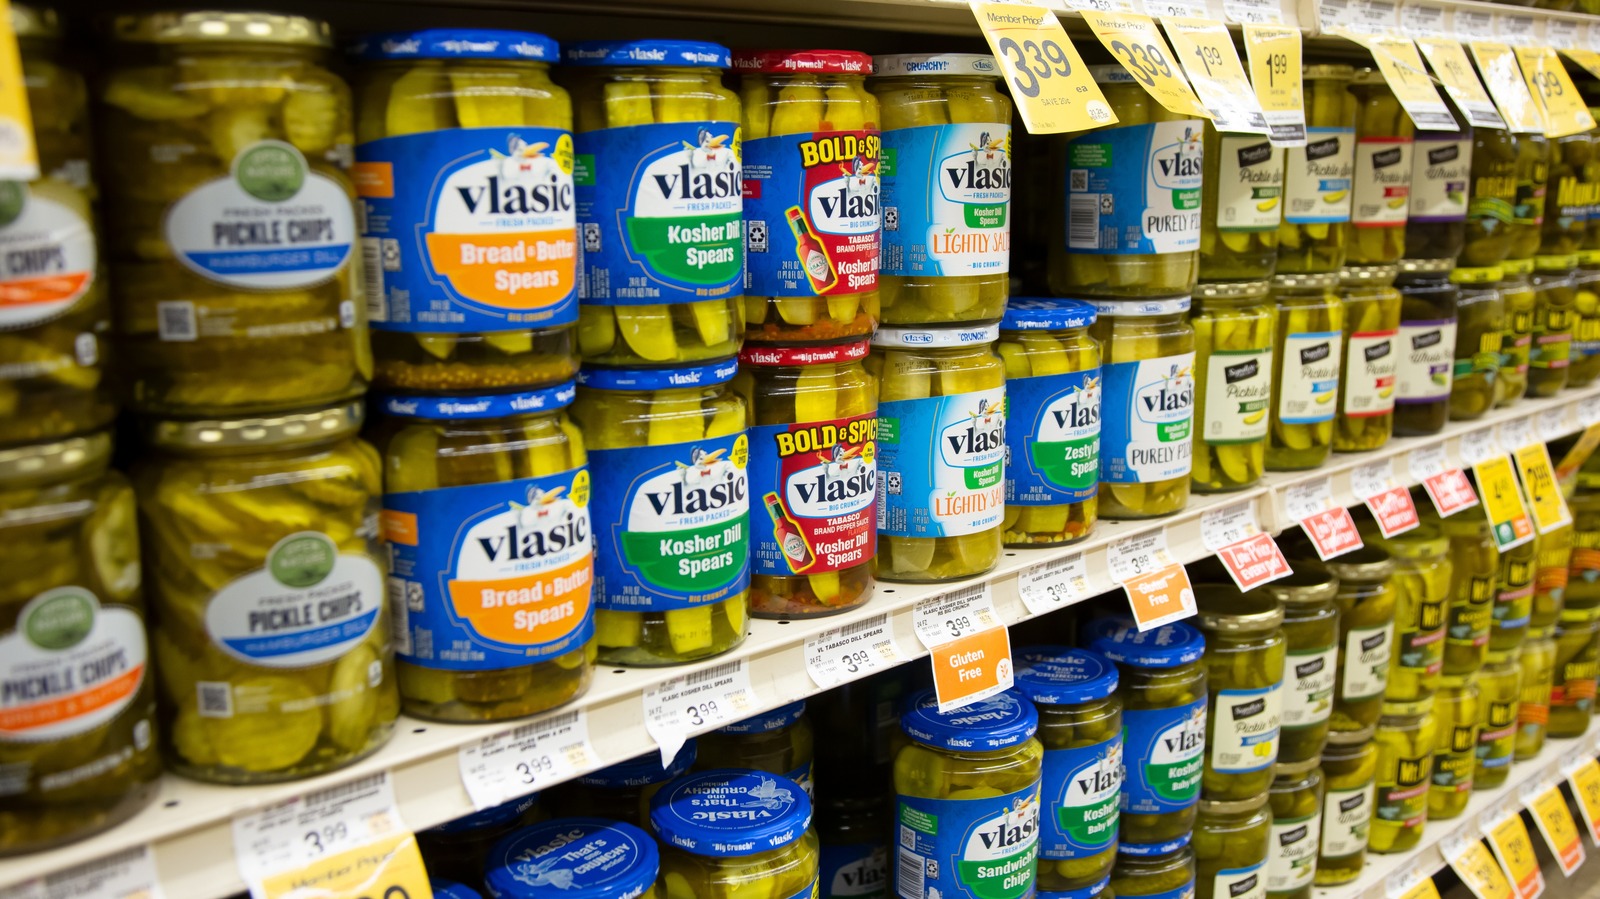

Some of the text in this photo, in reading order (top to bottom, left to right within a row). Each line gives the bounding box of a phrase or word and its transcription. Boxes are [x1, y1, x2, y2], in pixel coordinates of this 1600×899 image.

[987, 12, 1045, 26] Member Price!
[1096, 18, 1126, 29] Member
[629, 47, 666, 61] vlasic
[1195, 45, 1223, 77] 199
[734, 58, 763, 70] vlasic
[782, 59, 797, 70] "Big
[902, 60, 950, 73] "CRUNCHY!"
[999, 37, 1072, 98] 339
[1111, 40, 1172, 87] 339
[1266, 53, 1287, 87] 199
[1076, 85, 1088, 93] ea
[1041, 98, 1059, 106] SAVE
[800, 136, 857, 167] BOLD
[858, 139, 865, 153] &
[652, 162, 742, 200] vlasic
[945, 160, 1011, 190] vlasic
[455, 172, 572, 217] vlasic
[817, 184, 880, 219] vlasi
[687, 201, 733, 211] FRESH PACKED
[973, 207, 1003, 217] Kosher Dill
[849, 221, 859, 229] BIG
[979, 217, 999, 228] Spears
[1147, 212, 1188, 234] PURELY
[213, 218, 336, 247] PICKLE CHIPS
[667, 220, 741, 244] Kosher Dill
[848, 235, 875, 244] TABASCO
[836, 243, 871, 254] BRAND PEPPER
[933, 232, 991, 255] LIGHTLY
[459, 240, 526, 266] Bread
[686, 247, 734, 270] Spears
[837, 259, 871, 275] Kosher
[972, 261, 982, 269] BIG
[494, 269, 559, 295] Spears
[847, 273, 876, 290] Spears
[904, 334, 931, 342] vlasic
[750, 352, 782, 364] vlasic
[812, 351, 839, 362] Crunch!"
[669, 371, 702, 385] vlasic
[776, 425, 837, 457] BOLD
[839, 427, 847, 440] &
[848, 418, 878, 444] SPIC
[1065, 445, 1093, 461] Zesty
[1132, 446, 1175, 466] PURELY
[973, 467, 992, 478] Kosher
[1071, 459, 1098, 478] Spears
[794, 466, 875, 503] vlasic
[978, 475, 996, 486] Spears
[645, 472, 746, 516] vlasic
[828, 499, 860, 511] BIG CRUNCH
[935, 491, 989, 517] LIGHTLY
[679, 510, 730, 525] FRESH PACKED
[813, 517, 869, 536] BRAND PEPPER SAUCE
[826, 513, 861, 526] TABASCO
[478, 512, 586, 563] vlasic
[659, 522, 742, 557] Kosher Dill
[760, 541, 777, 550] 24 OZ
[815, 530, 869, 555] Kosher Dill
[678, 551, 733, 578] Spears
[827, 548, 862, 567] Spears
[1131, 554, 1150, 574] 399
[480, 566, 590, 609] Bread Butter
[1047, 582, 1068, 602] 399
[1138, 578, 1168, 596] Gluten
[923, 594, 983, 616] VLASIC KOSHER DILL SPEARS
[954, 603, 970, 612] CRUNCH
[1149, 594, 1170, 607] Free
[249, 590, 364, 633] PICKLE CHIPS
[513, 600, 575, 632] Spears
[916, 620, 922, 628] 24
[945, 616, 971, 637] 399
[825, 627, 883, 651] TABASCO DILL SPEARS
[810, 655, 822, 665] 24 FZ
[841, 650, 870, 674] 399
[949, 649, 985, 669] Gluten
[1024, 654, 1087, 665] vlasic
[1, 670, 76, 701] PICKLE
[80, 648, 129, 684] CHIPS
[958, 667, 983, 682] Free
[661, 677, 734, 703] VLASIC KOSHER DILL SPEARS
[686, 700, 718, 726] 399
[949, 710, 1013, 725] vlasic
[946, 737, 974, 747] vlasic
[986, 739, 998, 747] "Big
[516, 754, 553, 786] 399
[1168, 761, 1199, 779] Kosher
[684, 786, 748, 794] CRUNCHY
[1172, 780, 1189, 791] Baby
[691, 798, 741, 807] That's
[1083, 801, 1115, 822] Kosher
[692, 810, 773, 822] vlasic
[1087, 823, 1107, 835] Baby
[514, 828, 585, 863] vlasic
[712, 842, 756, 853] "Big Crunch!"
[769, 830, 794, 847] vlasic
[562, 838, 608, 862] That's
[573, 842, 631, 875] CRUNCHY
[583, 850, 603, 861] one
[1001, 845, 1018, 855] FRESH
[977, 853, 1032, 879] Sandwich
[1003, 868, 1031, 890] Chips
